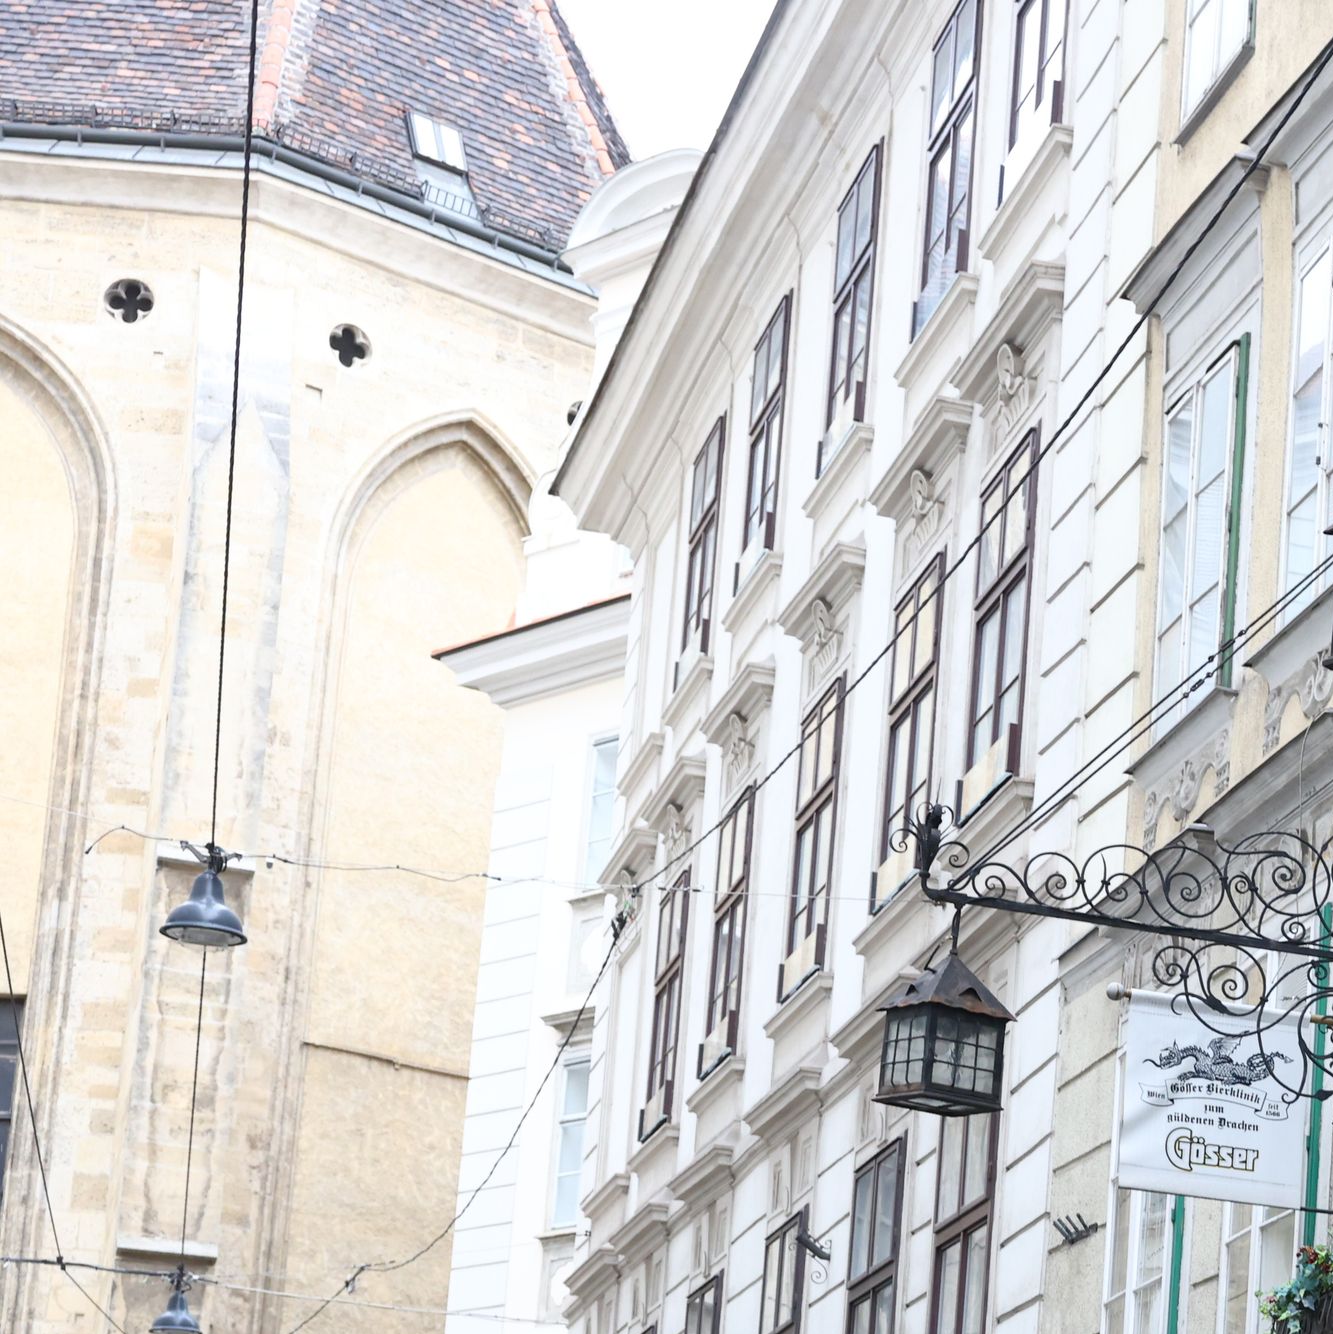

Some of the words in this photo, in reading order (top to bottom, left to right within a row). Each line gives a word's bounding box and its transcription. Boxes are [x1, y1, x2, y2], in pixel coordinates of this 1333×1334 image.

[1206, 1083, 1260, 1104] Bierklinik
[1204, 1104, 1224, 1114] zum
[1167, 1112, 1214, 1126] güldenen
[1218, 1117, 1259, 1132] Drachen
[1165, 1127, 1259, 1172] Gösser
